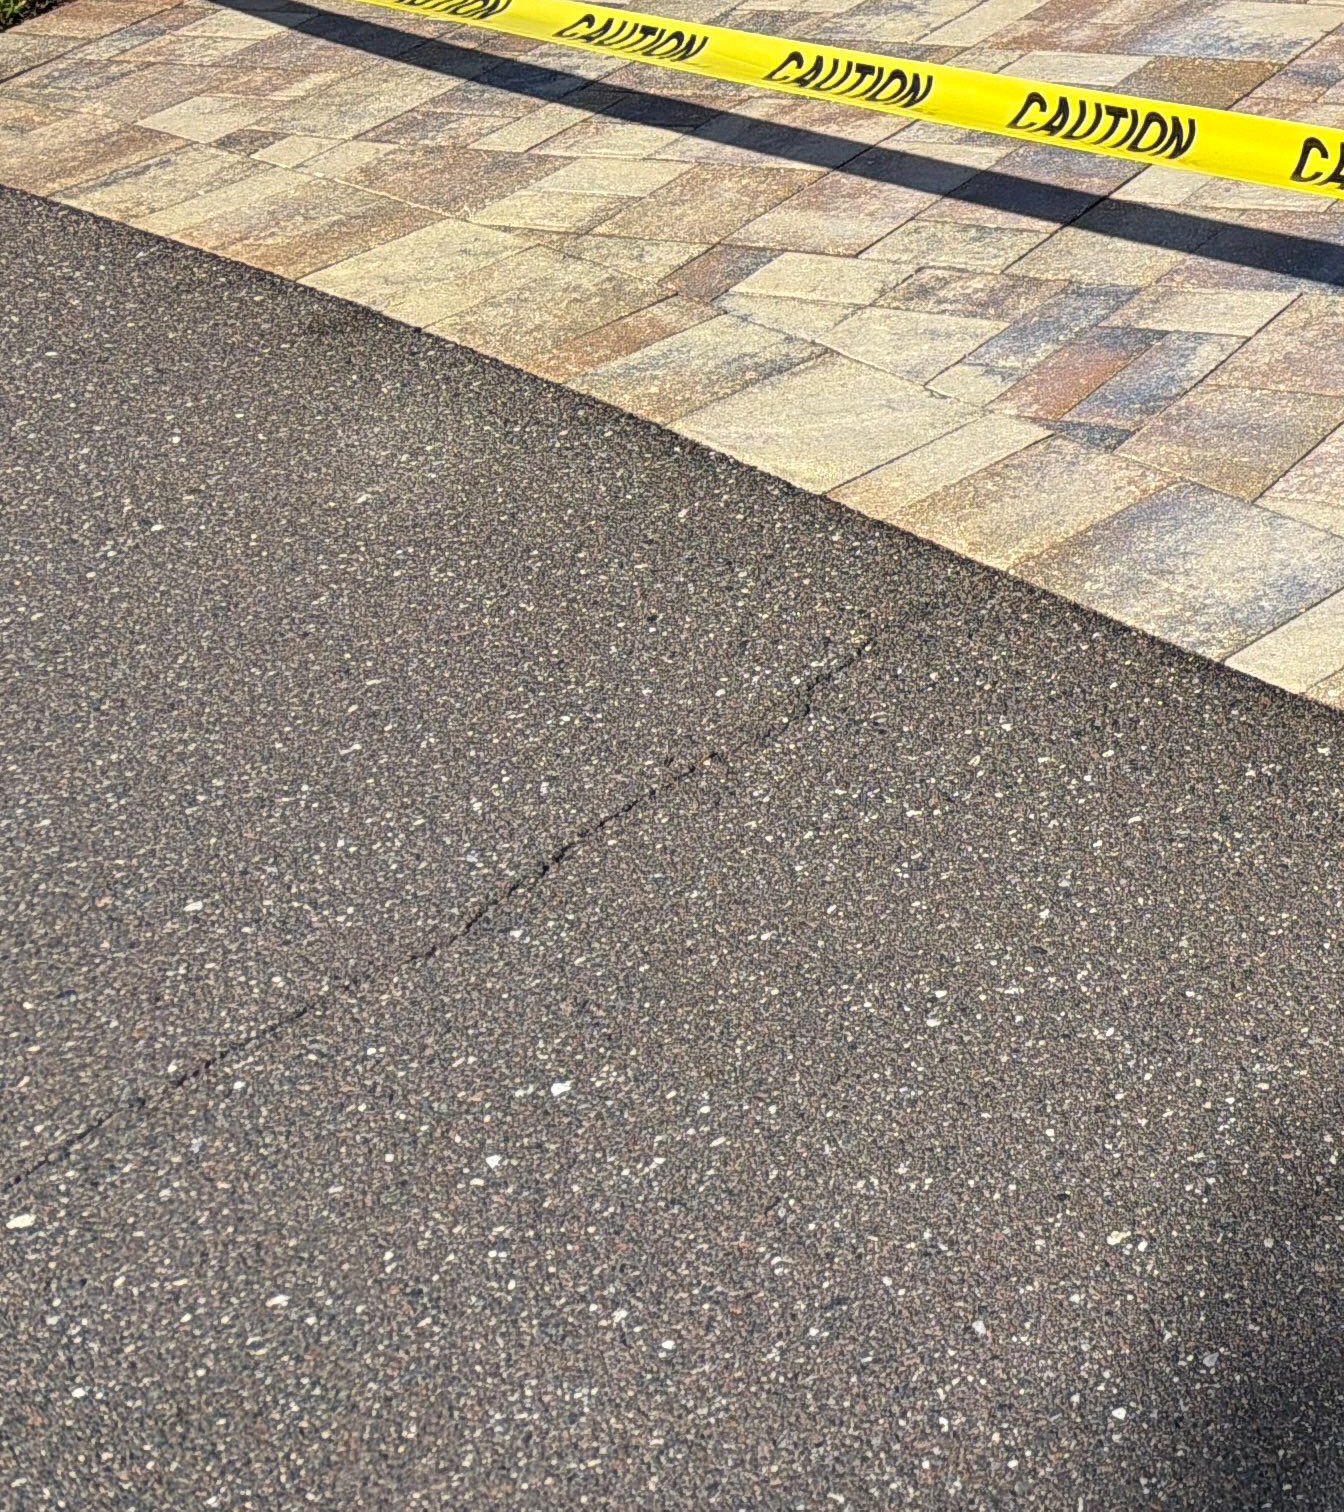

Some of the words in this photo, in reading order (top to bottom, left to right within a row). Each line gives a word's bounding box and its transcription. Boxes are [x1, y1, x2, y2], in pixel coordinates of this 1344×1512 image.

[553, 13, 709, 62] CAUTION
[764, 51, 934, 109] CAUTION
[1006, 92, 1197, 160] CAUTION
